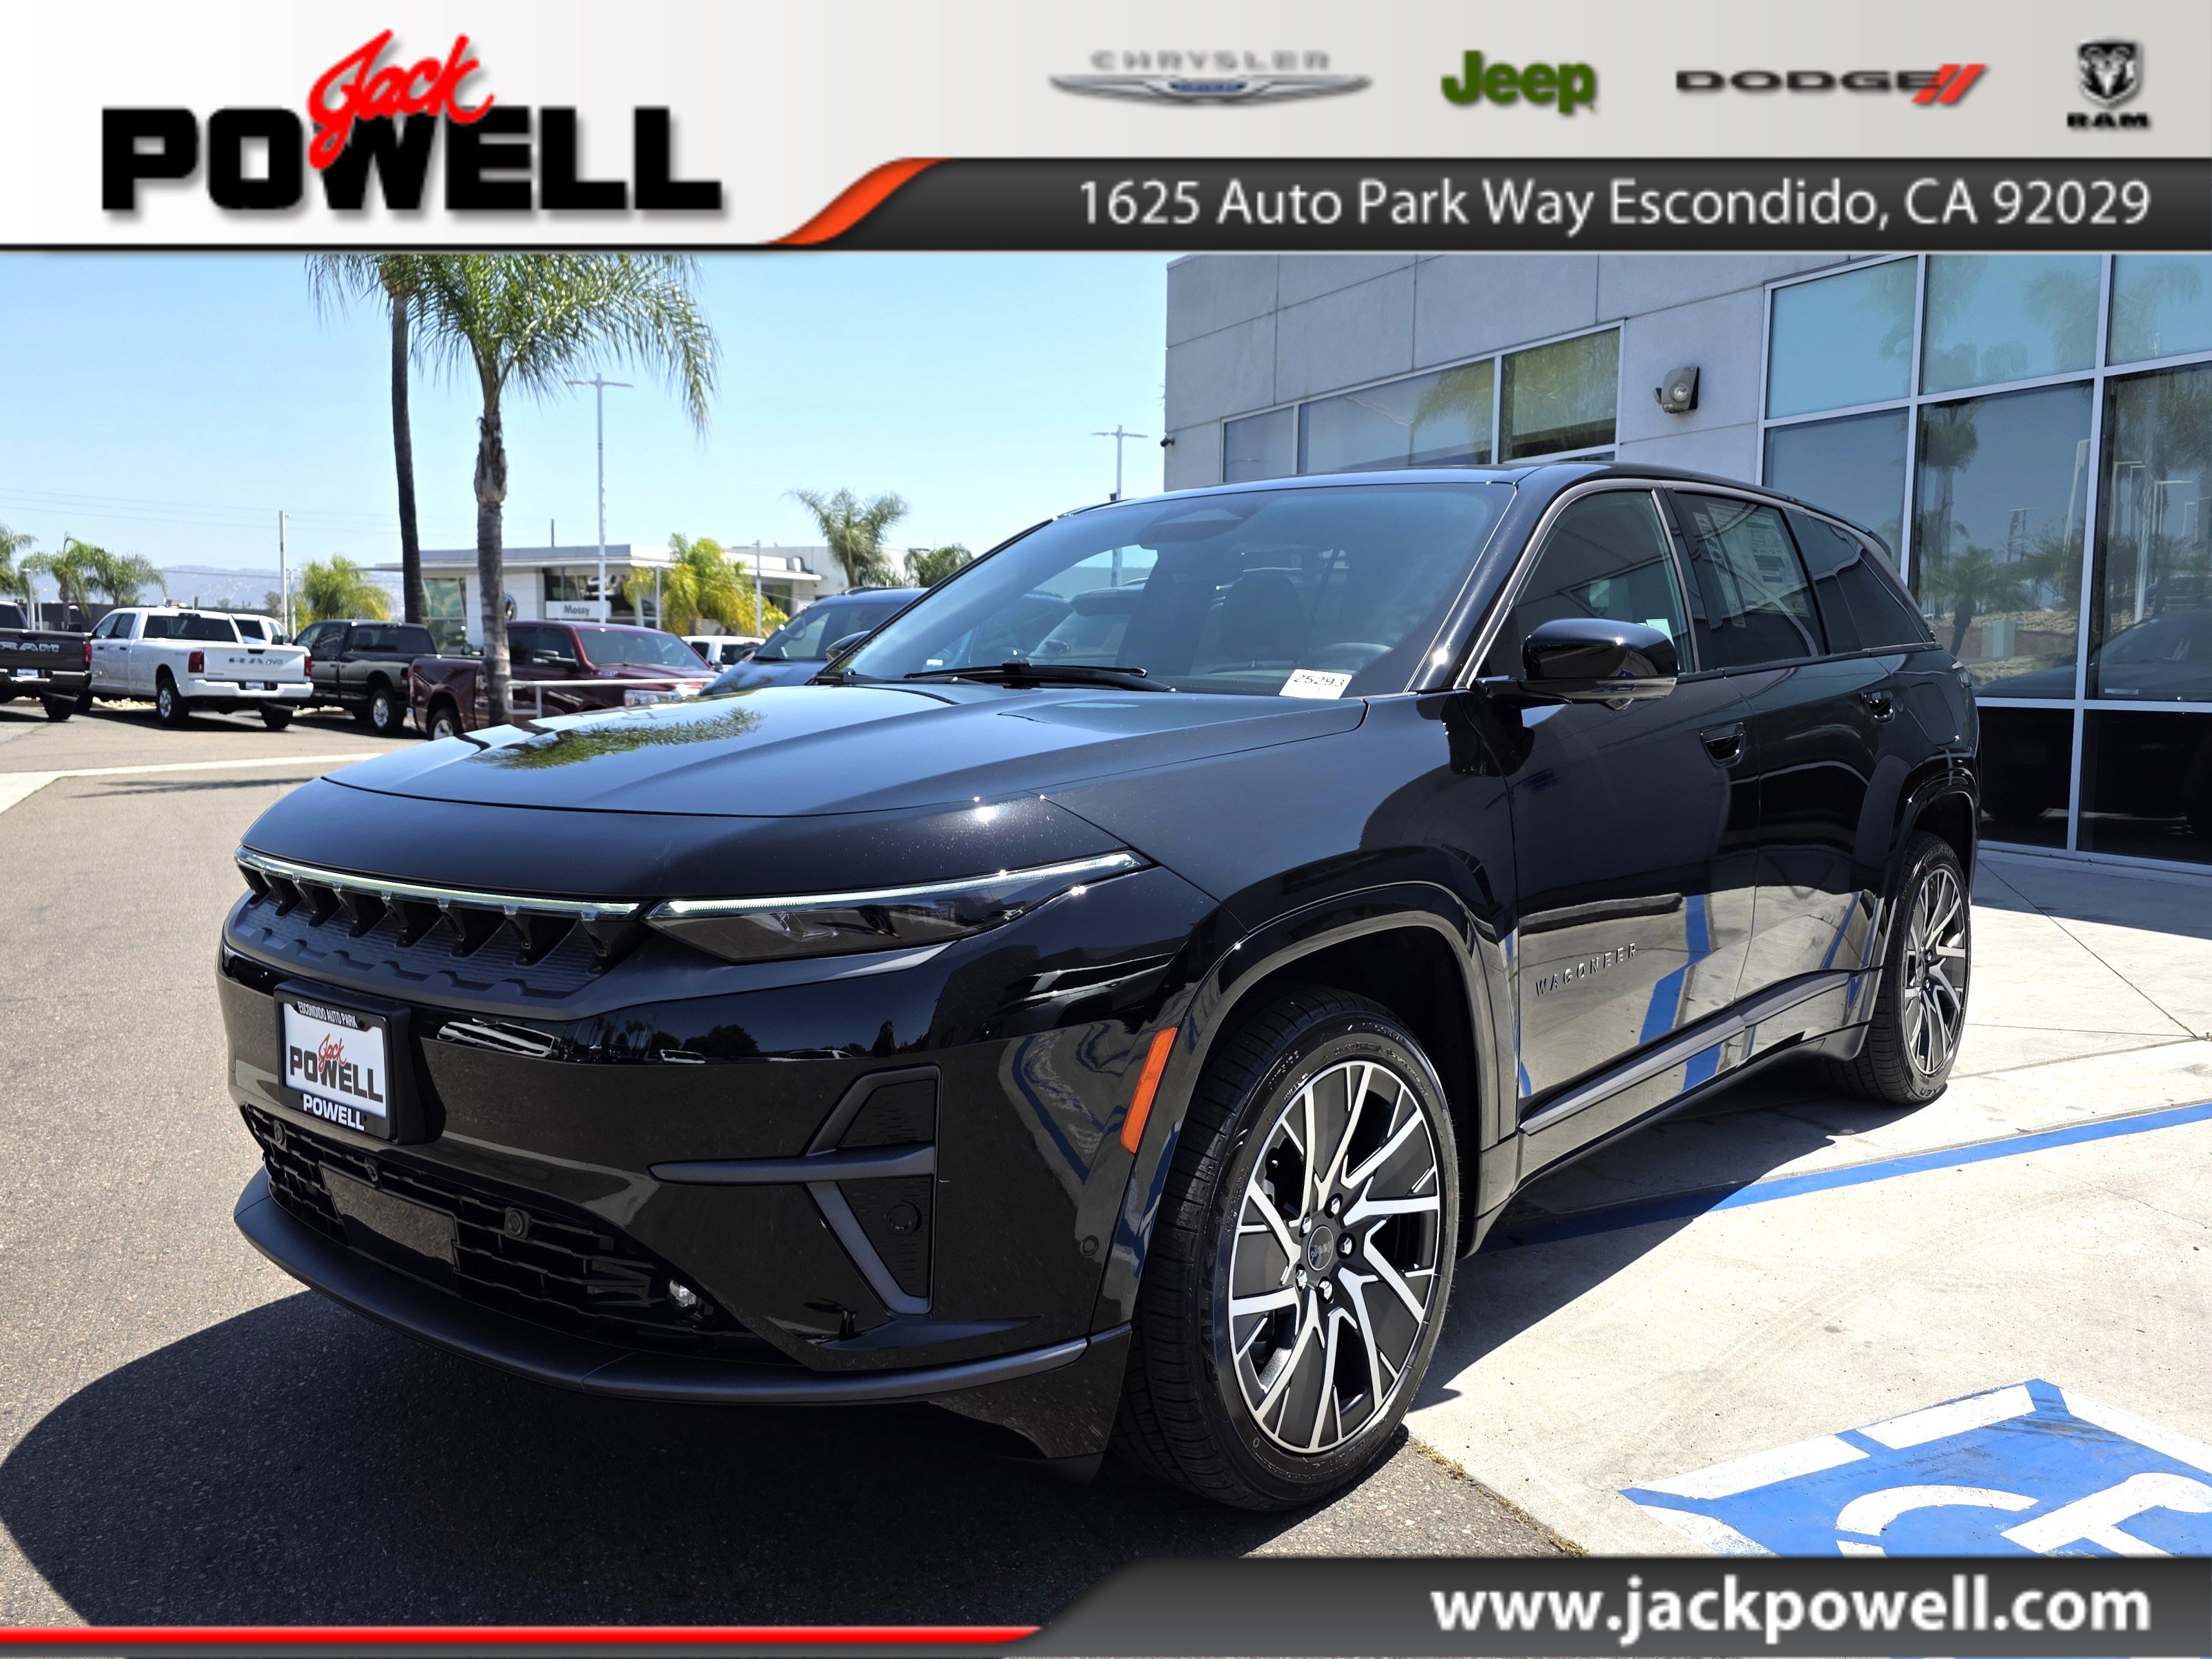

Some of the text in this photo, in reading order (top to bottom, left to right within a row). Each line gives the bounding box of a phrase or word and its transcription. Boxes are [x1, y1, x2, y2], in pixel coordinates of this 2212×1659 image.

[564, 604, 590, 616] Mossy
[1294, 674, 1345, 687] 25293
[1535, 943, 1637, 997] WAGONEER
[297, 1001, 358, 1028] ESCONDIDO AUTO PARK
[318, 1033, 347, 1073] Jack
[290, 1044, 383, 1104] POWELL
[303, 1093, 365, 1131] POWELL
